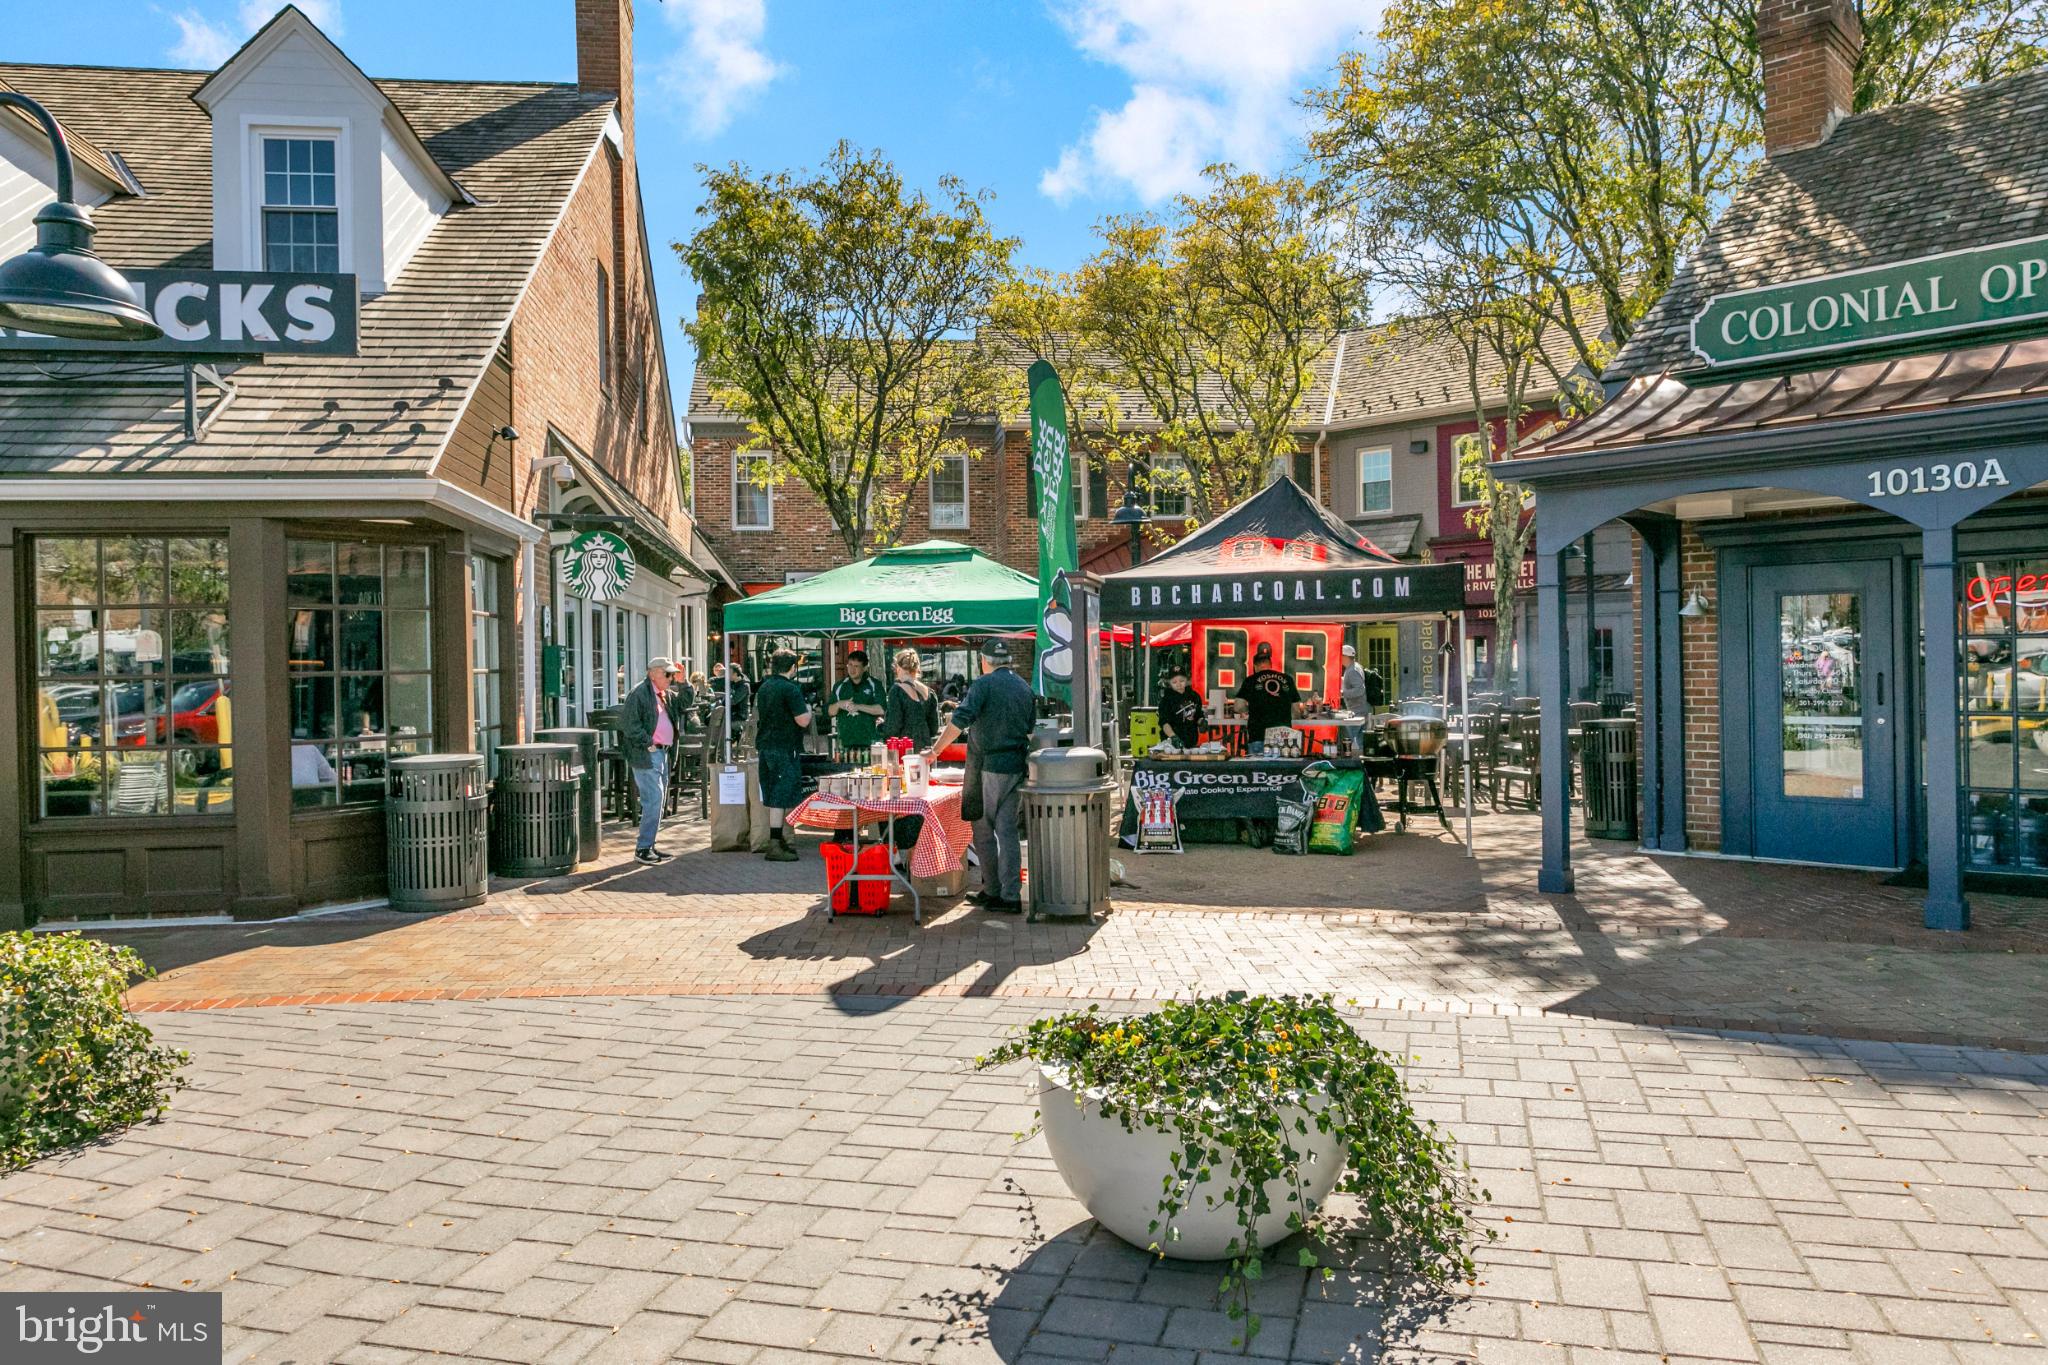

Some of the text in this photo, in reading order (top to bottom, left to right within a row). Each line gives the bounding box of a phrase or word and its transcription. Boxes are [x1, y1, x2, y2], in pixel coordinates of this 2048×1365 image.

[134, 281, 336, 343] CKS
[1721, 276, 1957, 345] COLONIAL
[1049, 434, 1066, 504] Egg
[1868, 458, 2009, 497] 10130A
[1486, 561, 1536, 579] MET
[1131, 576, 1410, 606] BBCHARCOAL.COM
[1472, 581, 1496, 592] RIVE
[840, 606, 954, 625] Big Green Egg
[1135, 771, 1297, 789] Big Green Egg
[1200, 787, 1234, 795] Cooking
[1237, 785, 1282, 794] Experience
